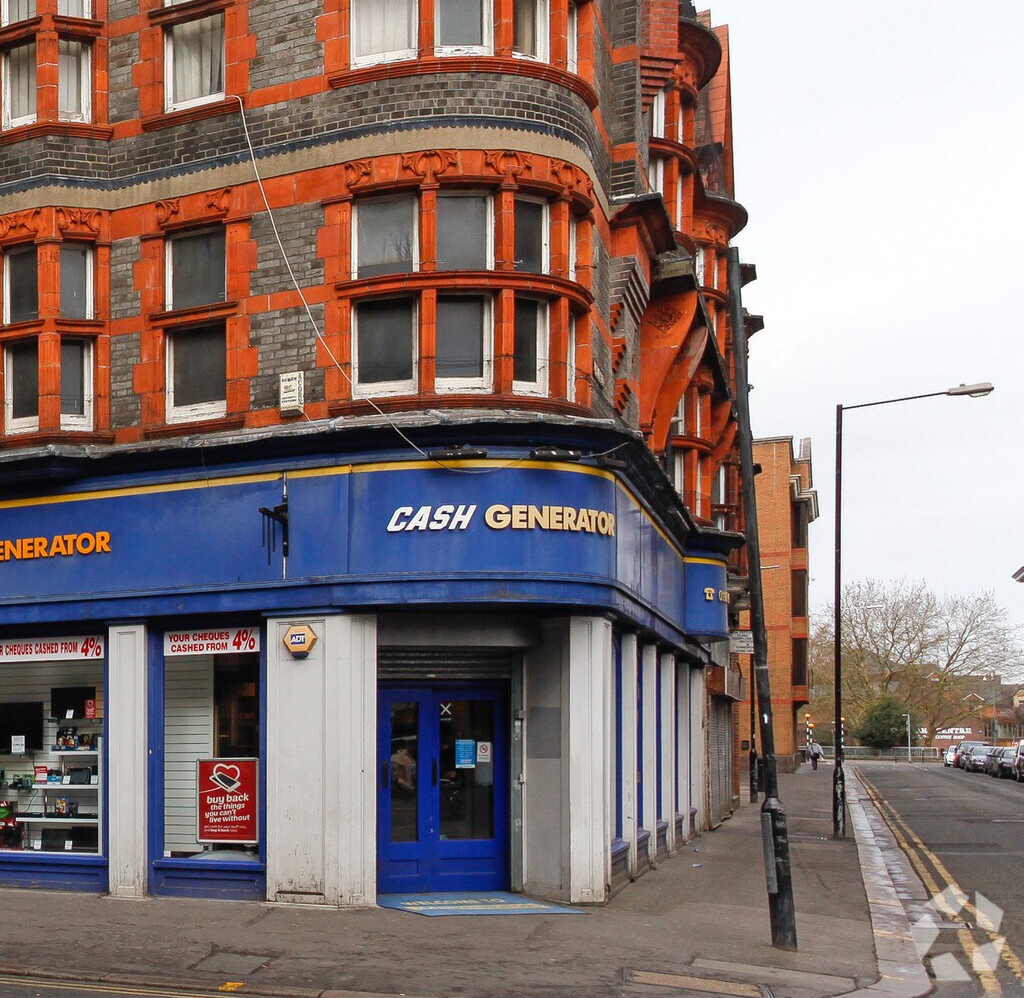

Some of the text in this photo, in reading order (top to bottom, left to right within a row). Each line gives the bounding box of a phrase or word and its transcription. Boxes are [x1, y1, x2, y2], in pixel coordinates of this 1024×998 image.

[386, 504, 615, 536] CASH GENERATOR
[168, 631, 229, 642] YOUR CHEQUES
[232, 629, 255, 650] 4%
[291, 635, 304, 643] ADT
[5, 644, 33, 655] CHEQUES
[35, 642, 59, 654] CASHED
[60, 642, 78, 653] FROM
[81, 637, 102, 657] 4%
[171, 642, 228, 652] CASHED FROM
[206, 793, 249, 804] buy back
